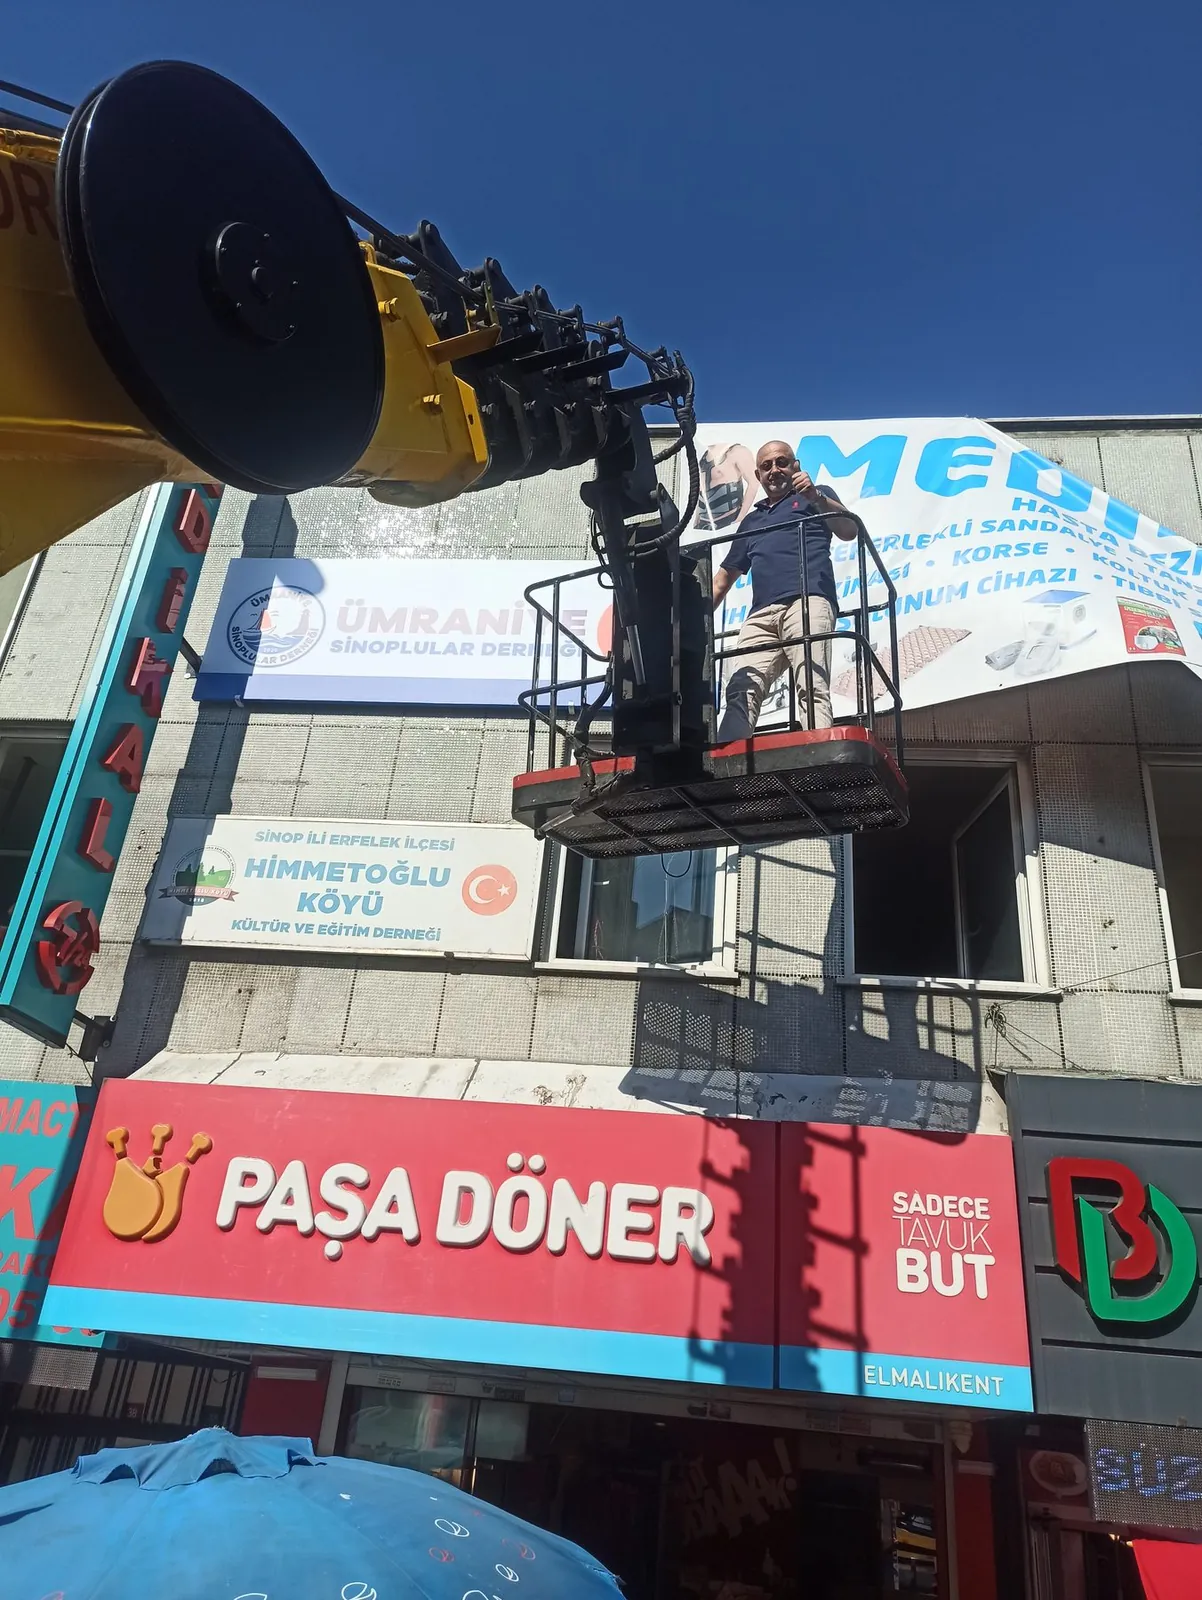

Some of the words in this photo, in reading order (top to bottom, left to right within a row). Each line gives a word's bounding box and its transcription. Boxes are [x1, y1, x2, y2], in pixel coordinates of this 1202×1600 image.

[979, 518, 1118, 556] SANDALYE
[1012, 496, 1119, 548] HASTA
[952, 541, 1048, 567] KORSE
[1092, 551, 1188, 601] KOLTUK
[976, 567, 1077, 594] CİHAZI
[330, 637, 474, 656] SİNOPLULAR
[254, 829, 304, 844] SİNOP
[307, 830, 327, 845] İLİ
[329, 834, 401, 849] ERFELEK
[404, 834, 455, 852] İLÇESİ
[243, 855, 451, 888] HİMMETOĞLU
[296, 888, 384, 917] KÖYÜ
[231, 917, 290, 934] KÜLTÜR
[294, 922, 315, 935] VE
[317, 920, 370, 938] EĞİTİM
[372, 924, 442, 942] DERNEĞİ
[215, 1156, 420, 1261] PAŞA
[436, 1151, 716, 1266] DÖNER
[892, 1216, 993, 1253] TAVUK
[895, 1247, 996, 1300] BUT
[863, 1364, 1004, 1396] ELMALIKENT
